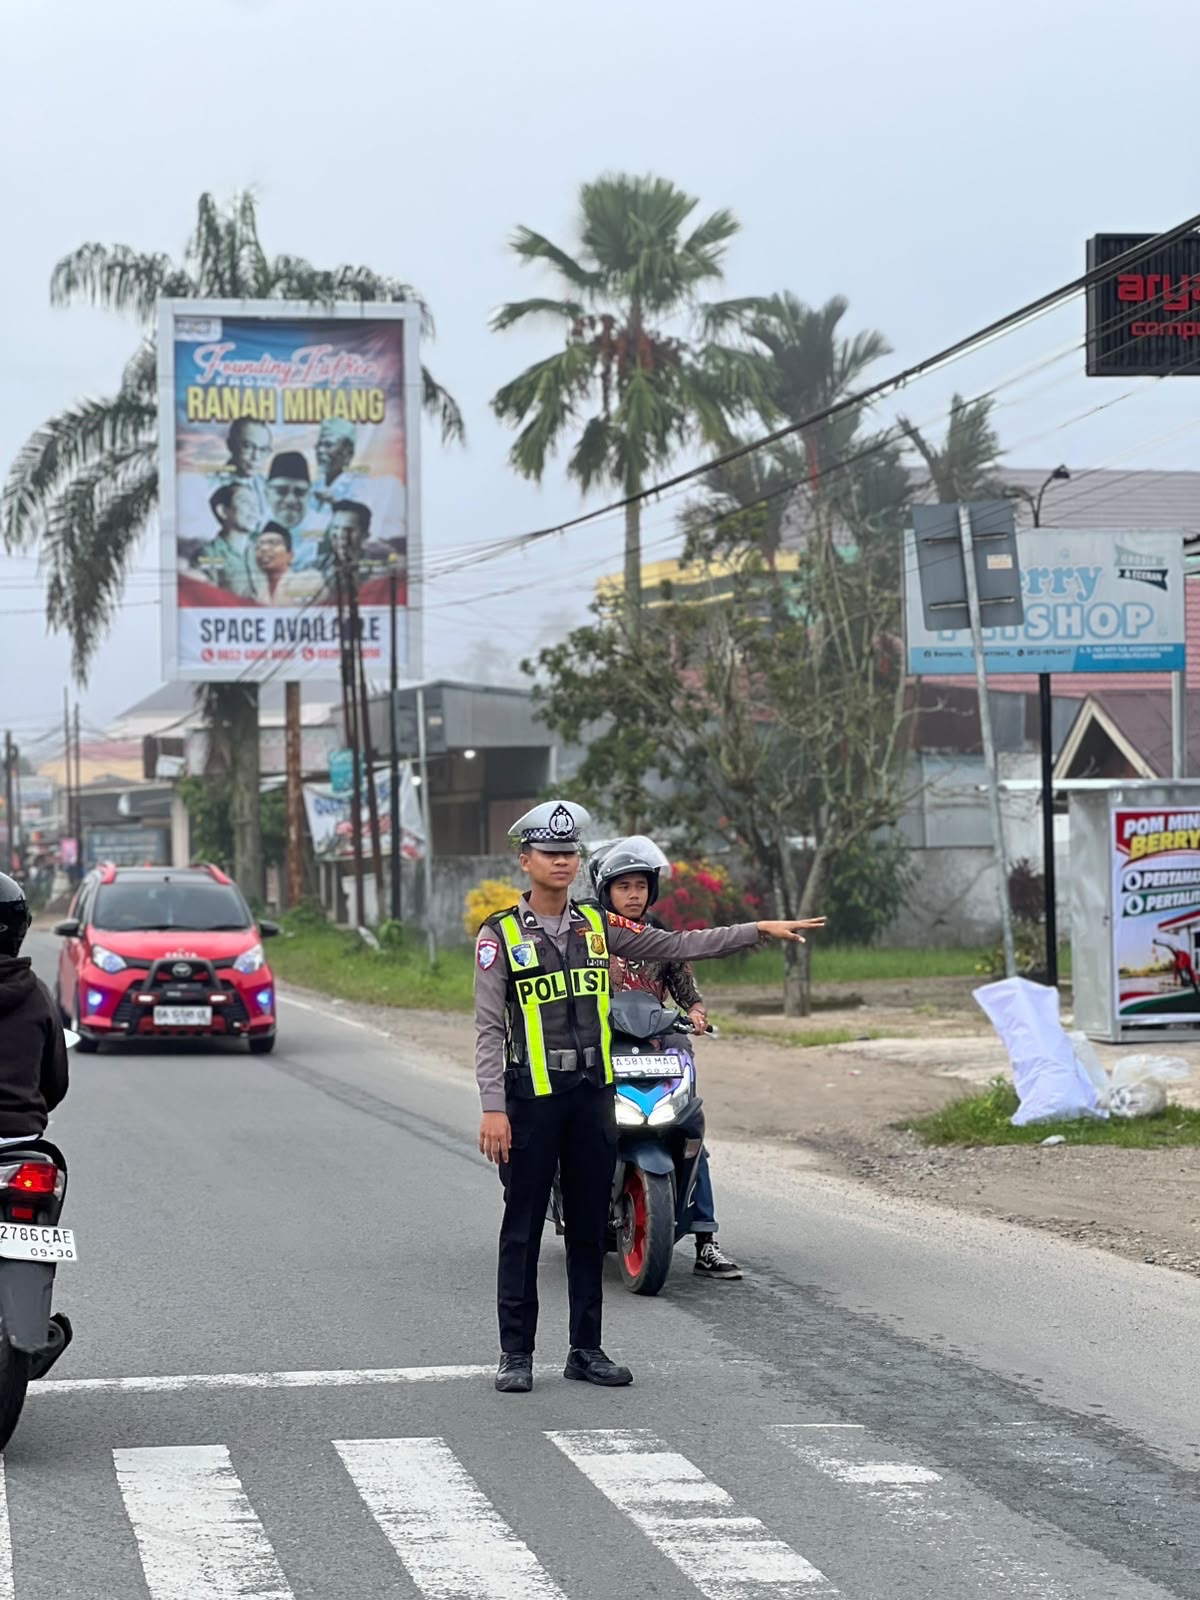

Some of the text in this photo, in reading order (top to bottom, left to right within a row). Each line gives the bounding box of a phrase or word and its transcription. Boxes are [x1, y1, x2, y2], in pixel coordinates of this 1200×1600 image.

[193, 342, 294, 387] Founding
[187, 386, 386, 423] RANAH MINANG
[200, 617, 265, 642] SPACE
[1123, 815, 1165, 839] POM
[1130, 829, 1200, 859] BERRY
